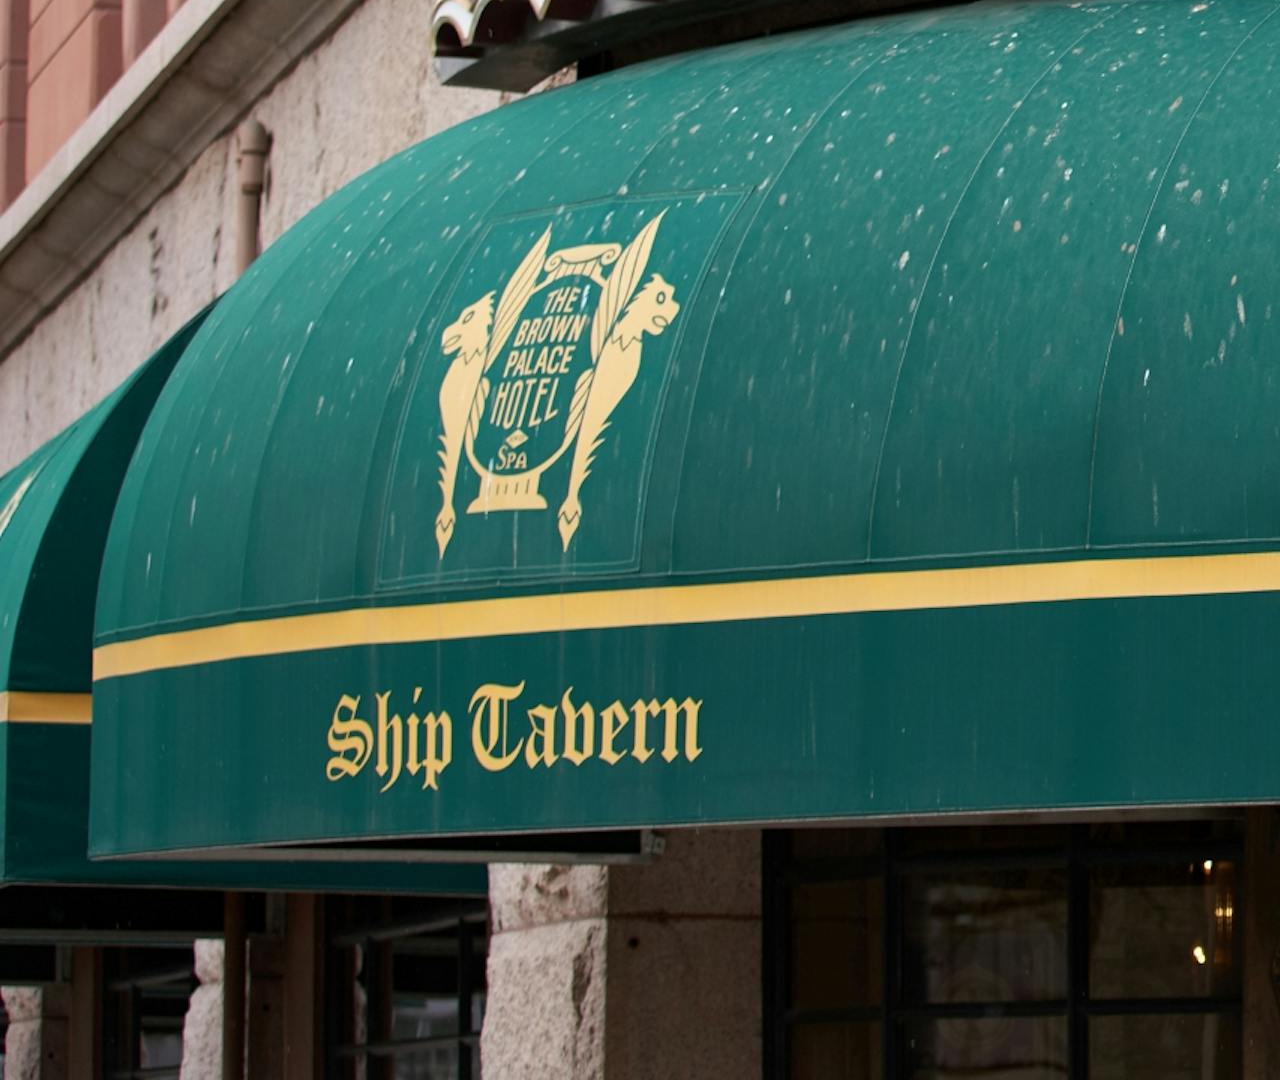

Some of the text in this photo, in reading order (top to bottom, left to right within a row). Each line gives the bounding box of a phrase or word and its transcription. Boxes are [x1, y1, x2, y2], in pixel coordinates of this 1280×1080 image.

[543, 286, 582, 315] THE
[513, 314, 588, 347] BROWN
[503, 345, 576, 378] PALACE
[490, 378, 559, 430] HOTEL
[326, 679, 703, 793] Ship Tavern
